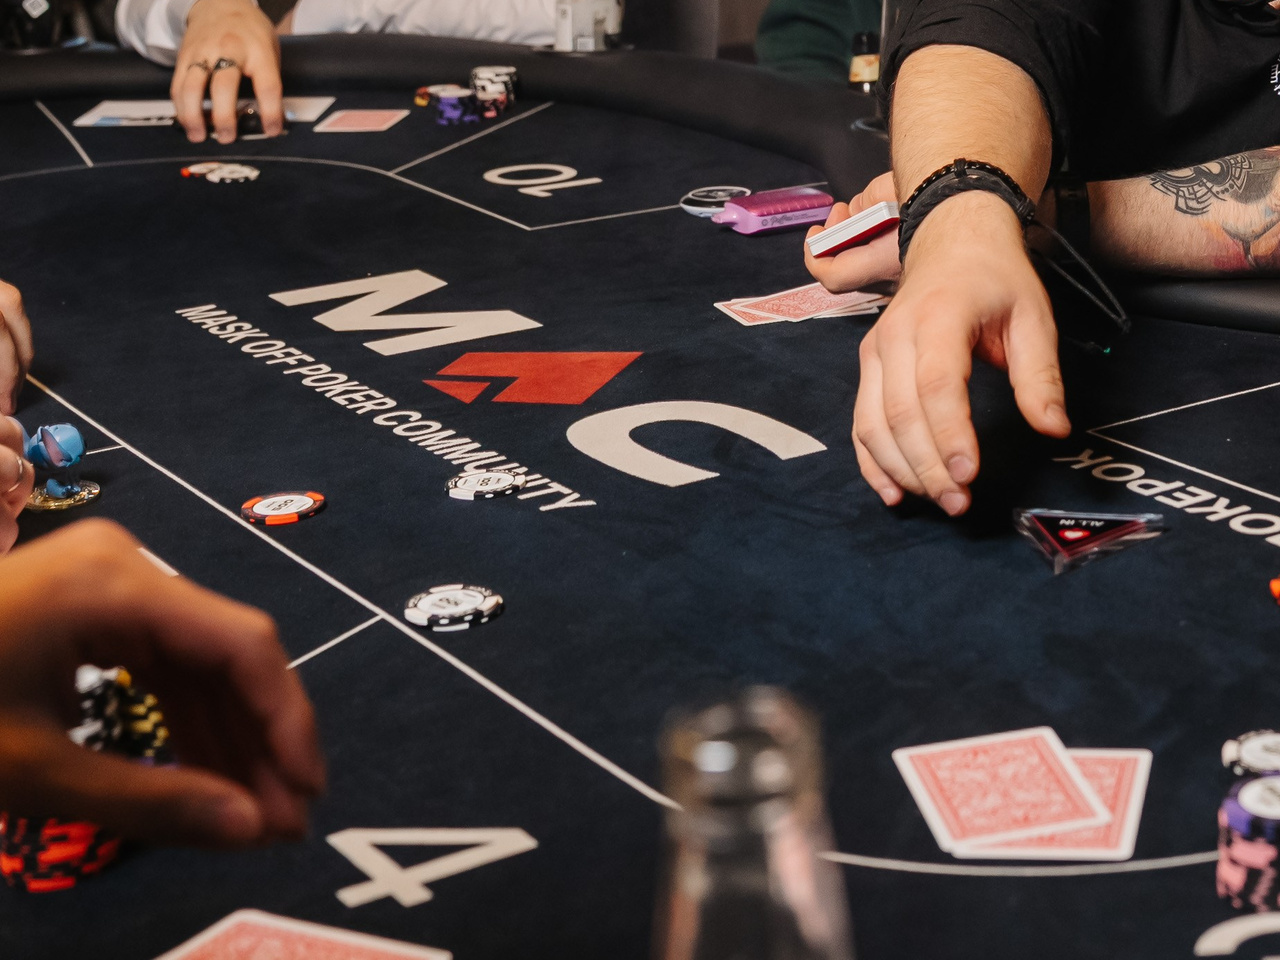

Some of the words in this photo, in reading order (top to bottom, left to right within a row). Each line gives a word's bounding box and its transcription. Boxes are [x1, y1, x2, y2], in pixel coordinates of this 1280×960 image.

[174, 303, 270, 344] MASK
[240, 339, 316, 366] OFF
[283, 363, 398, 415] POKER
[325, 826, 540, 909] 4
